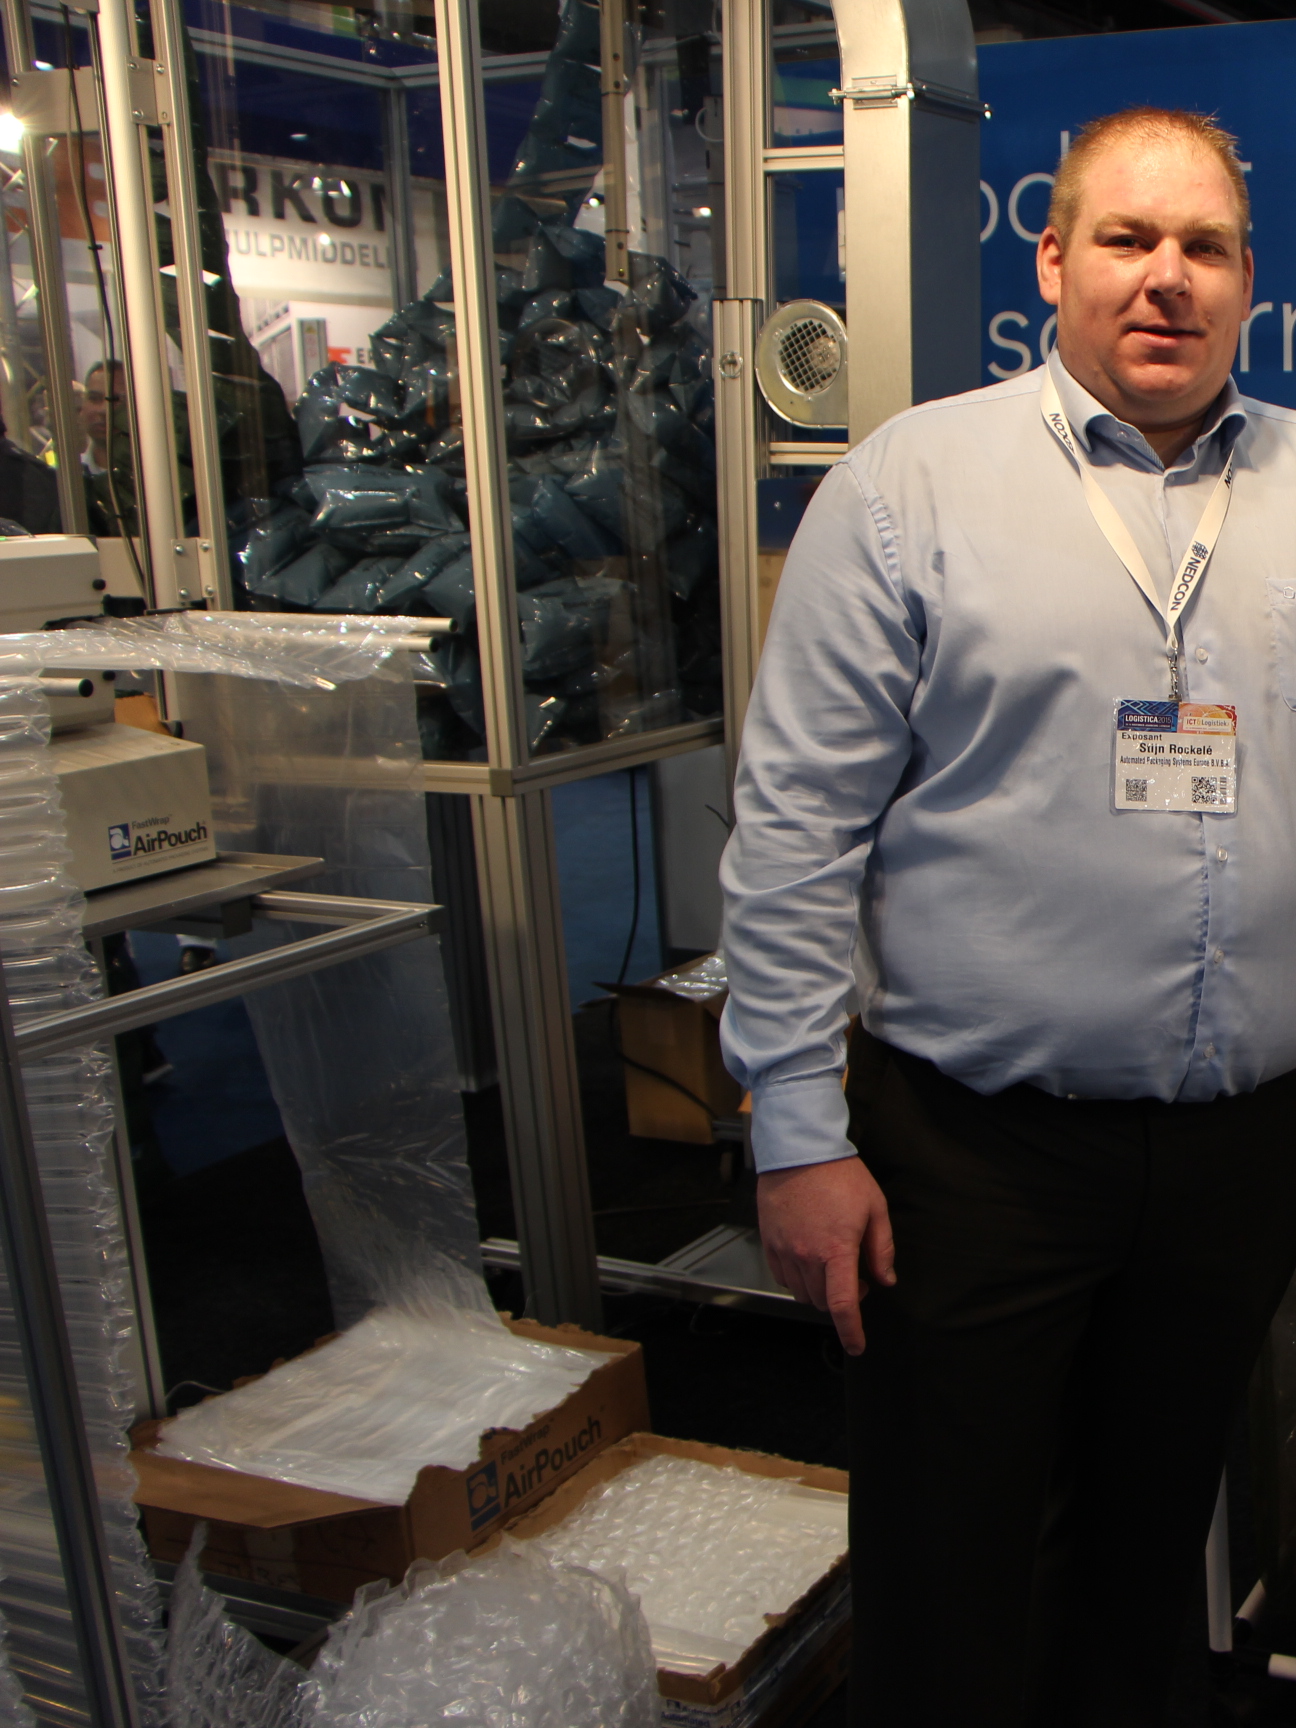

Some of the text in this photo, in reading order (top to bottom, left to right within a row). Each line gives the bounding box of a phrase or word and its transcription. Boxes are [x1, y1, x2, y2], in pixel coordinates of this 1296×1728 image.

[226, 228, 391, 269] ULPMIDDEL
[1170, 556, 1202, 612] NEDCON
[1121, 732, 1163, 741] Exposant
[1139, 743, 1213, 755] Stijn Rockelé
[133, 821, 208, 856] AirPouch
[504, 1416, 602, 1508] AirPouch
